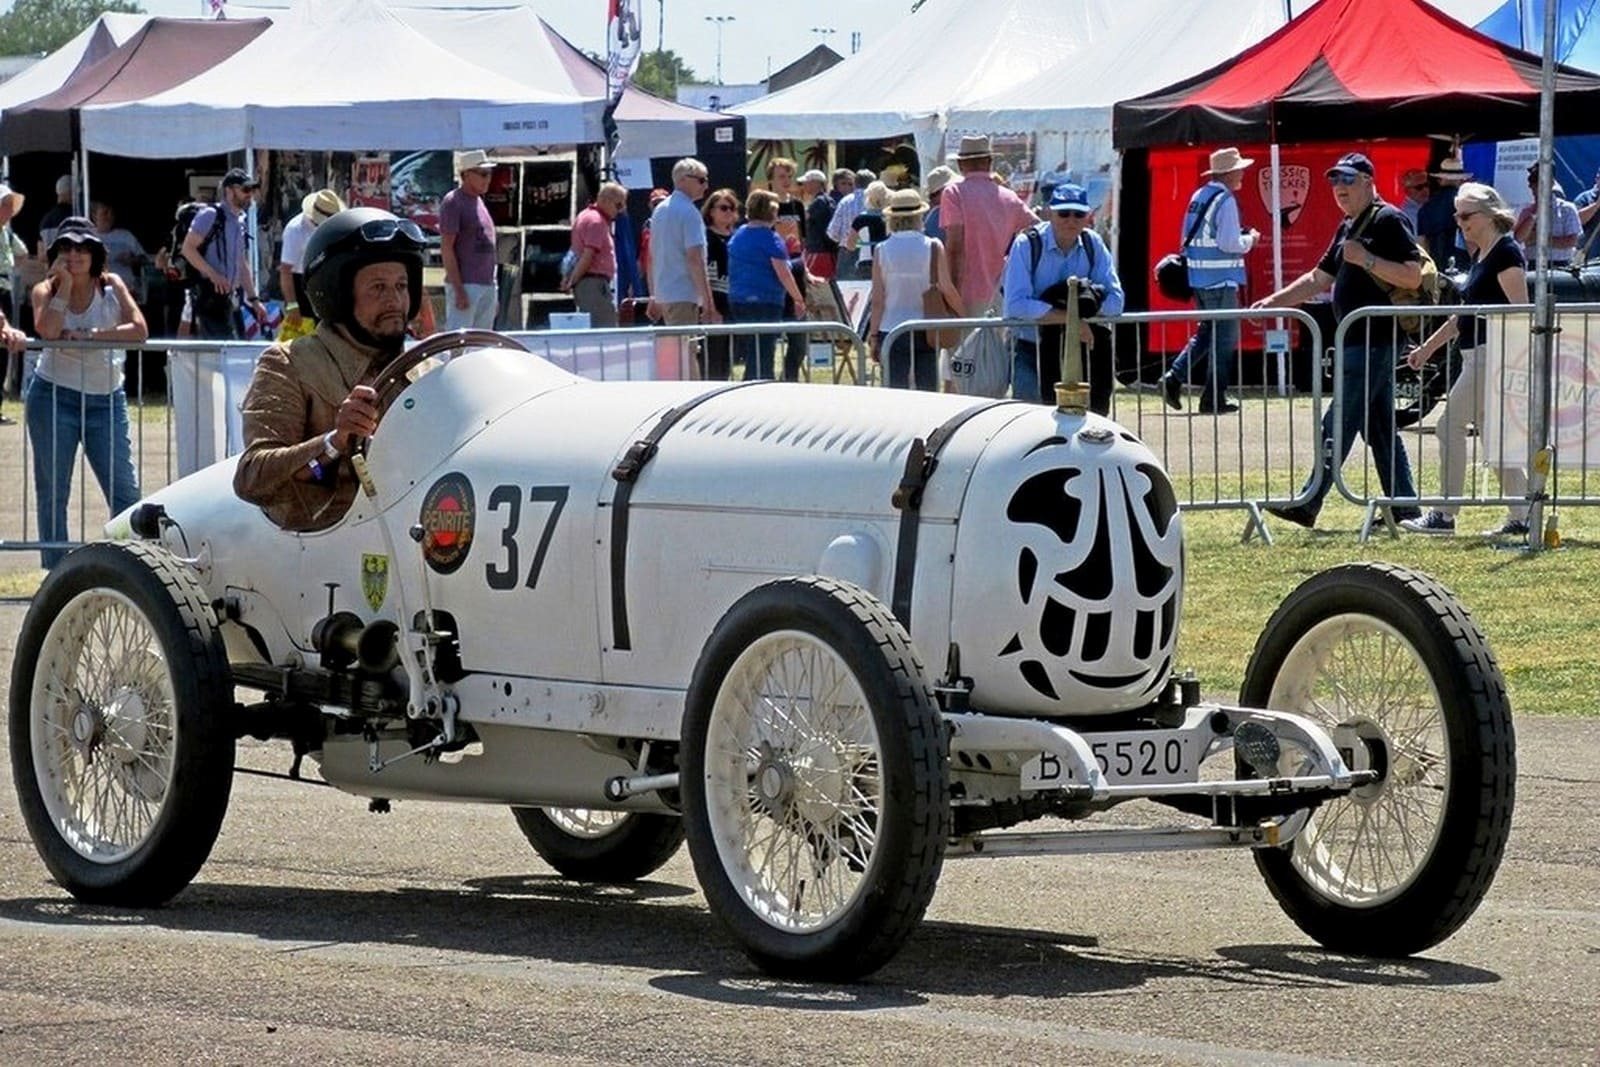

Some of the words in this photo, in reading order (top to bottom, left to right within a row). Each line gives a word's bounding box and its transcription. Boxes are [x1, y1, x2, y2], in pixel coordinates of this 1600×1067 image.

[1262, 167, 1308, 180] CSSIC
[1263, 179, 1307, 192] TCKER
[424, 510, 471, 531] PENRITE
[485, 484, 570, 590] 37
[1092, 739, 1181, 776] 5520
